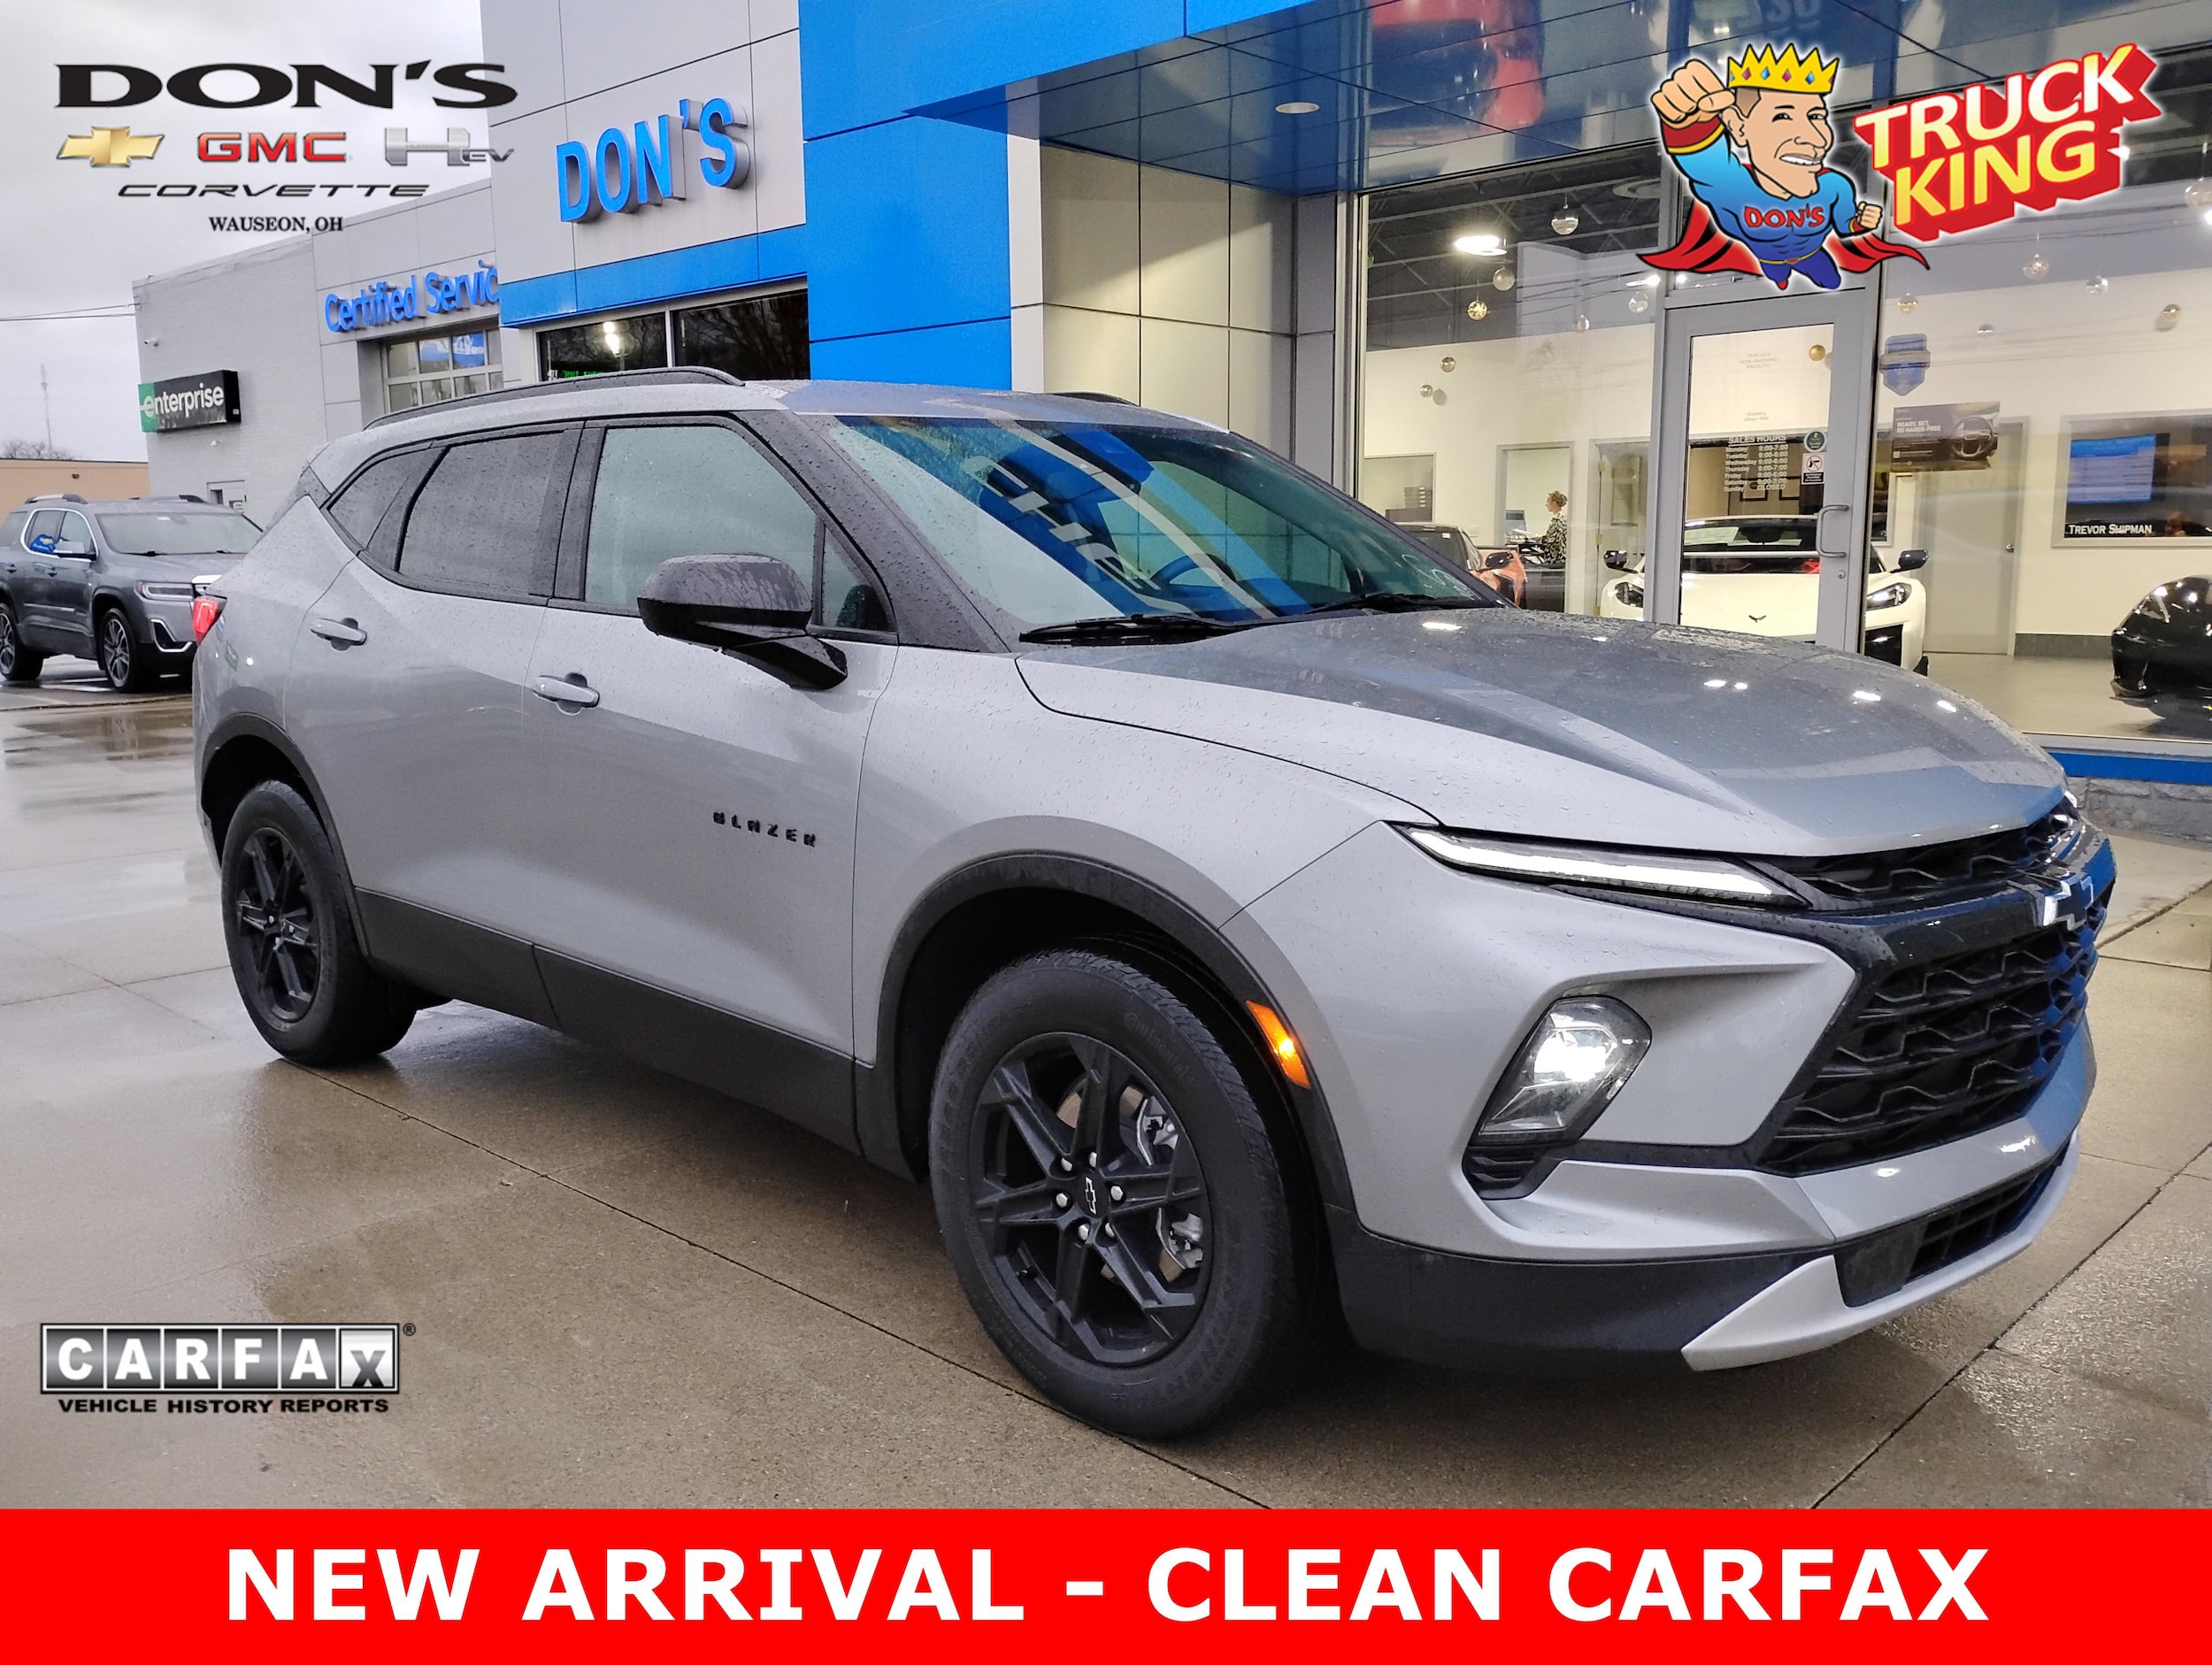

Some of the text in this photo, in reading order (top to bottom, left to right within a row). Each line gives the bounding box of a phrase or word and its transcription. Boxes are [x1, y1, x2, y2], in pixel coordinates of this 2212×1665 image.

[557, 97, 743, 222] DON'S
[325, 259, 500, 333] Certified Servic
[141, 382, 225, 418] enterprise
[2069, 523, 2153, 534] TREVOR SHIPMAN
[713, 811, 816, 848] BLAZER
